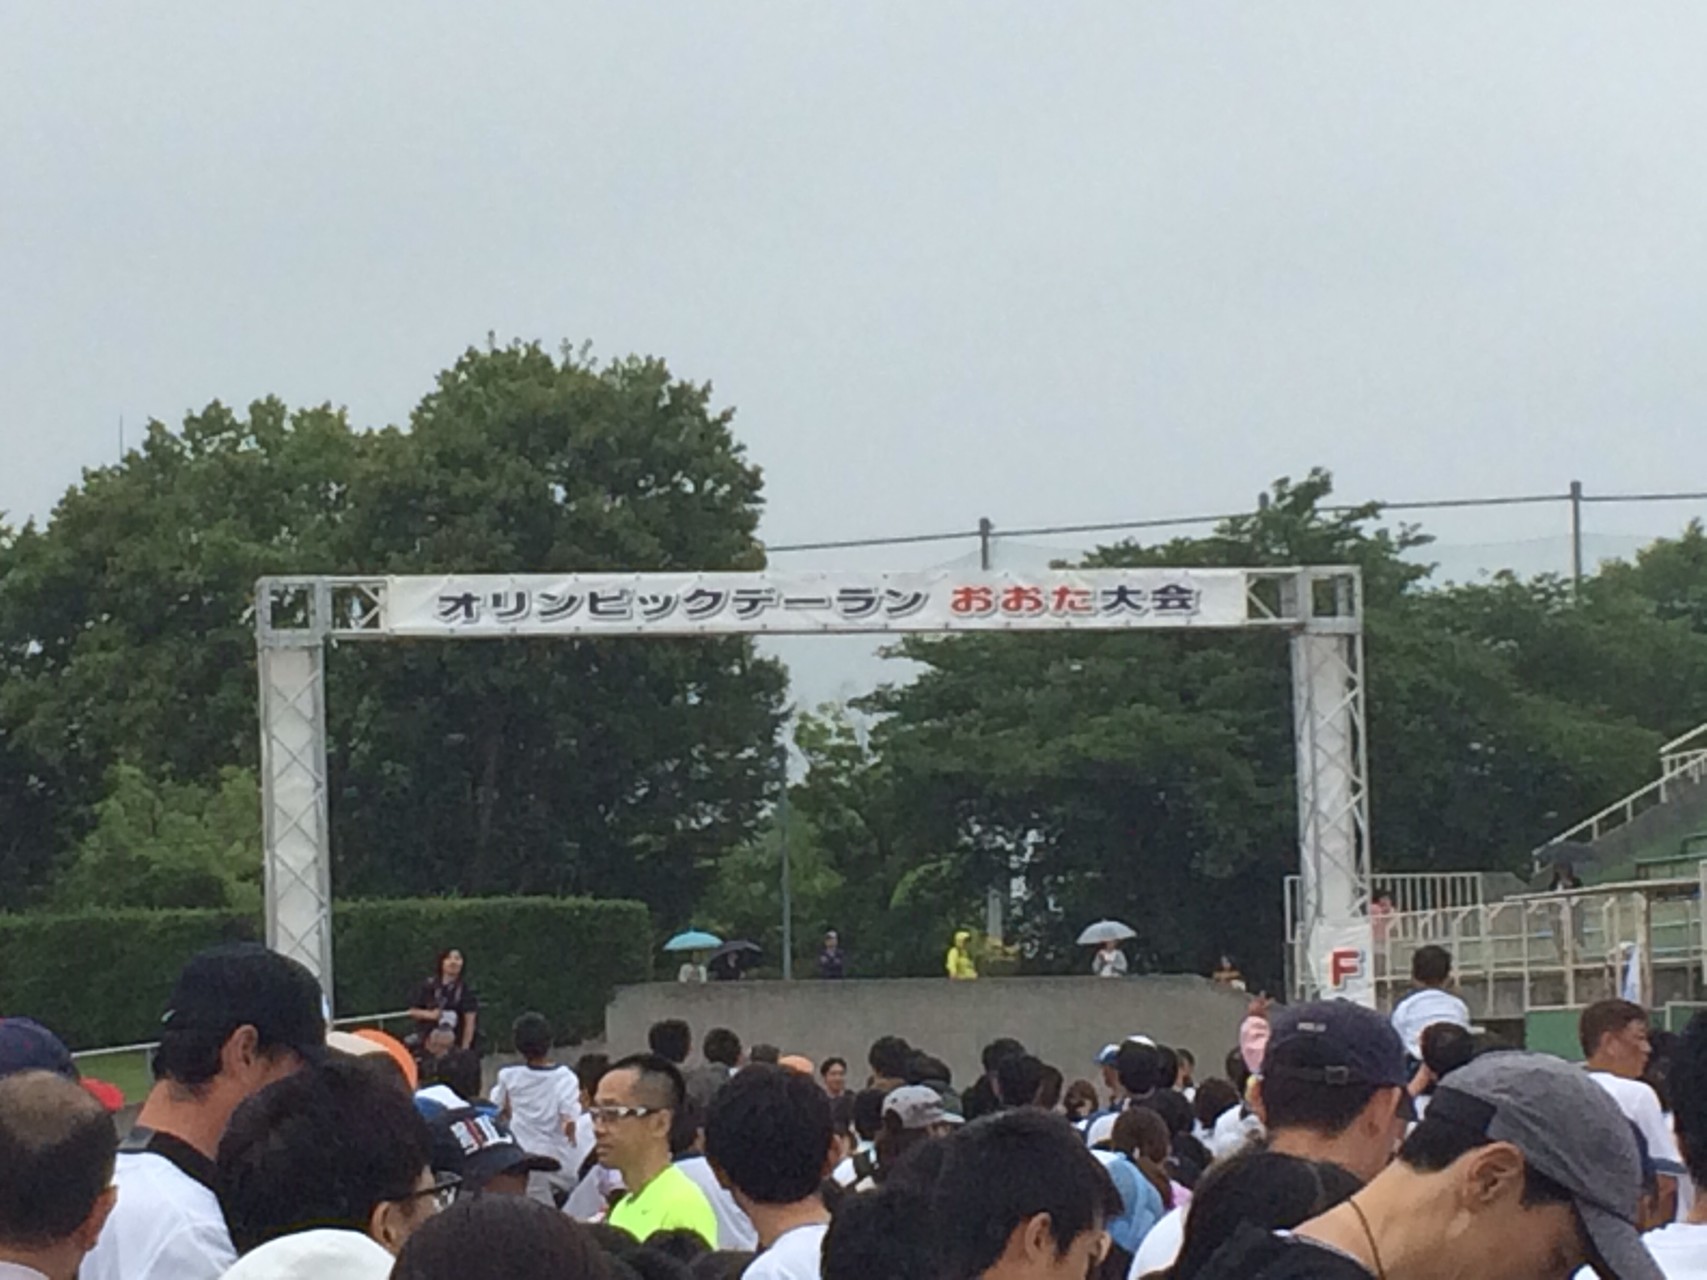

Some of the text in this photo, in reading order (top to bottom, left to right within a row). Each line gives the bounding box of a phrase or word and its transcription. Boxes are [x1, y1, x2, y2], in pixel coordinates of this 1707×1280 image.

[437, 584, 1200, 620] オリンピックデーラン おおた大会
[1331, 949, 1362, 988] F
